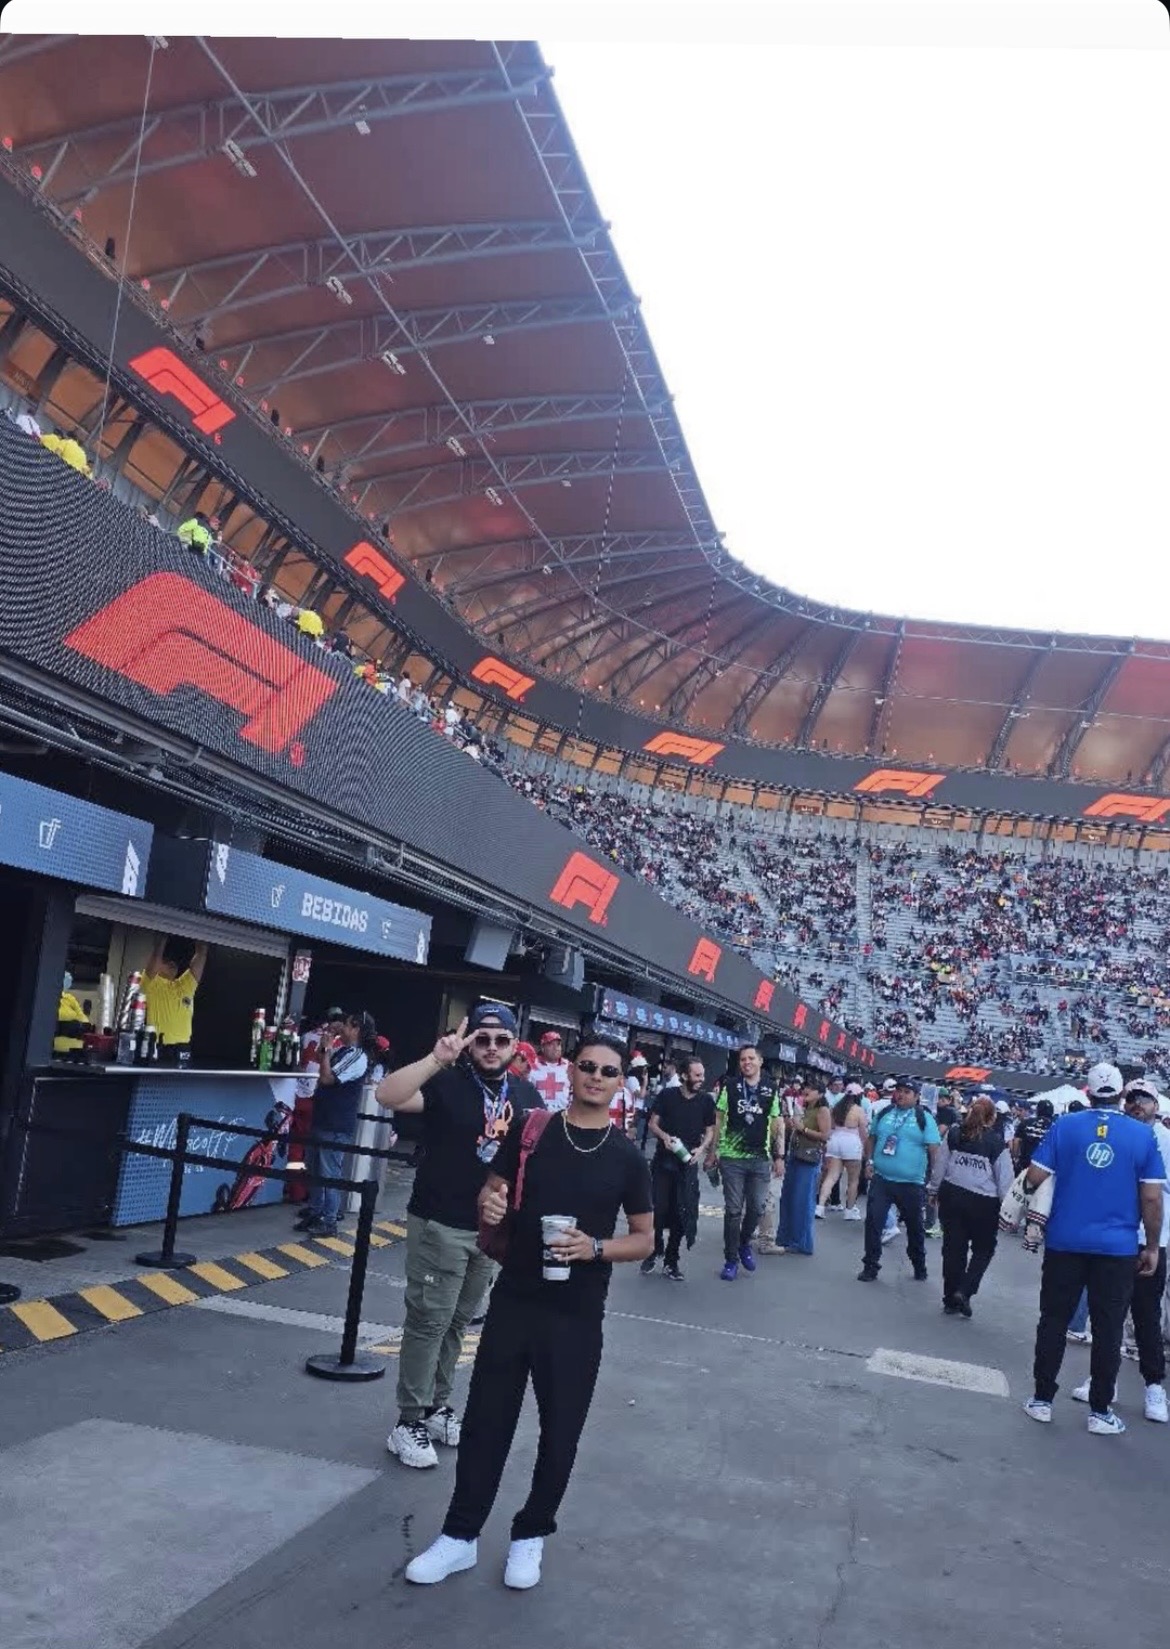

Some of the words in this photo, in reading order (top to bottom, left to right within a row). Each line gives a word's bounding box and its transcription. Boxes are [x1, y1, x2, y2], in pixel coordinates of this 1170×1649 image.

[129, 347, 237, 436] F1
[64, 571, 337, 756] F1
[643, 731, 725, 765] F1
[853, 769, 947, 797] F1
[301, 892, 369, 933] BEBIDAS
[1090, 1144, 1112, 1167] hp
